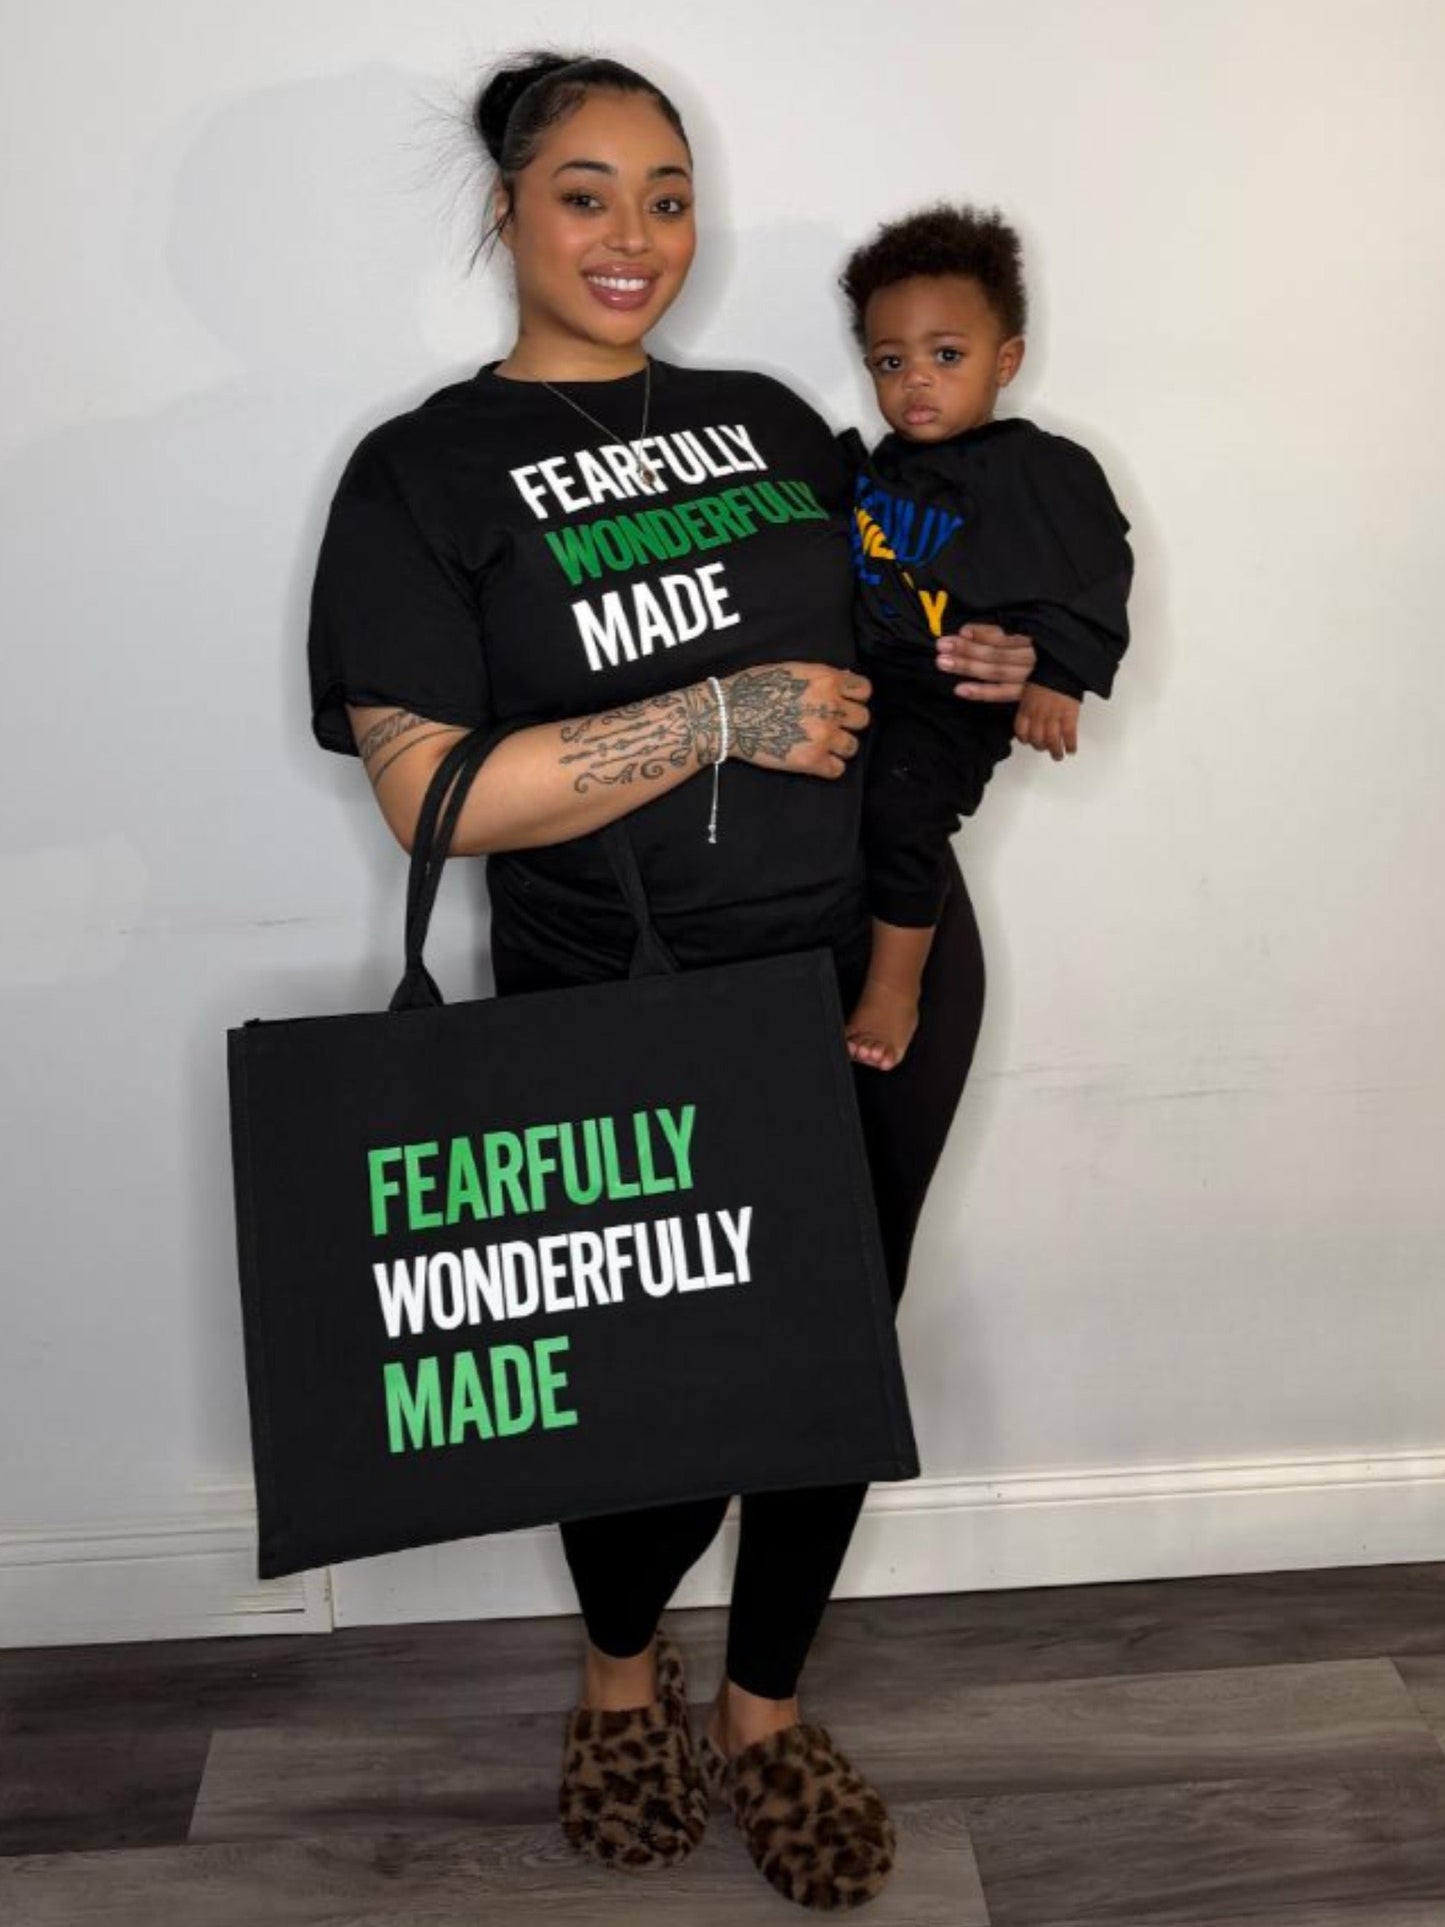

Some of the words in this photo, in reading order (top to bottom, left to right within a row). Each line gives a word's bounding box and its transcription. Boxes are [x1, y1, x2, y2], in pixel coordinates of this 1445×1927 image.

[509, 424, 768, 519] FEARFULLY
[545, 481, 829, 586] WONDERFULLY
[571, 562, 741, 672] MADE
[368, 1104, 696, 1237] FEARFULLY
[373, 1206, 753, 1338] WONDERFULLY
[383, 1336, 578, 1454] MADE
